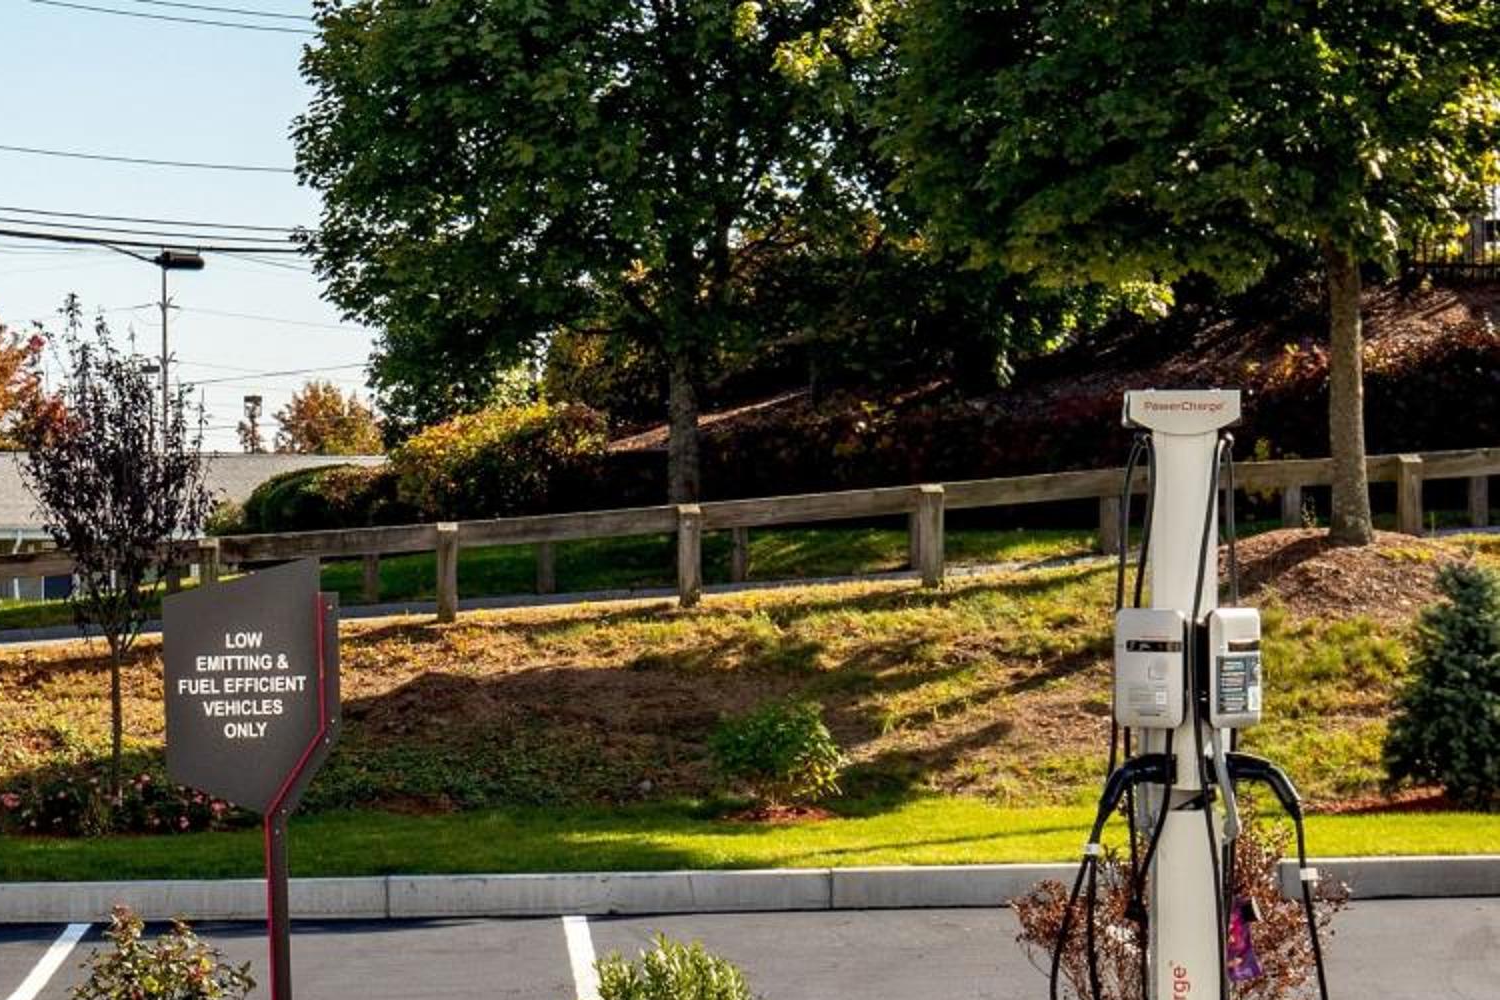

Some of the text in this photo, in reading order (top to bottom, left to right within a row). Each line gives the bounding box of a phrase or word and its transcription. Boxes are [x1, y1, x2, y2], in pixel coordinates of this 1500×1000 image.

[225, 632, 263, 649] LOW
[196, 653, 289, 671] EMITTING &
[178, 675, 307, 695] FUEL EFFICIENT
[203, 699, 283, 717] VEHICLES
[223, 722, 267, 739] ONLY
